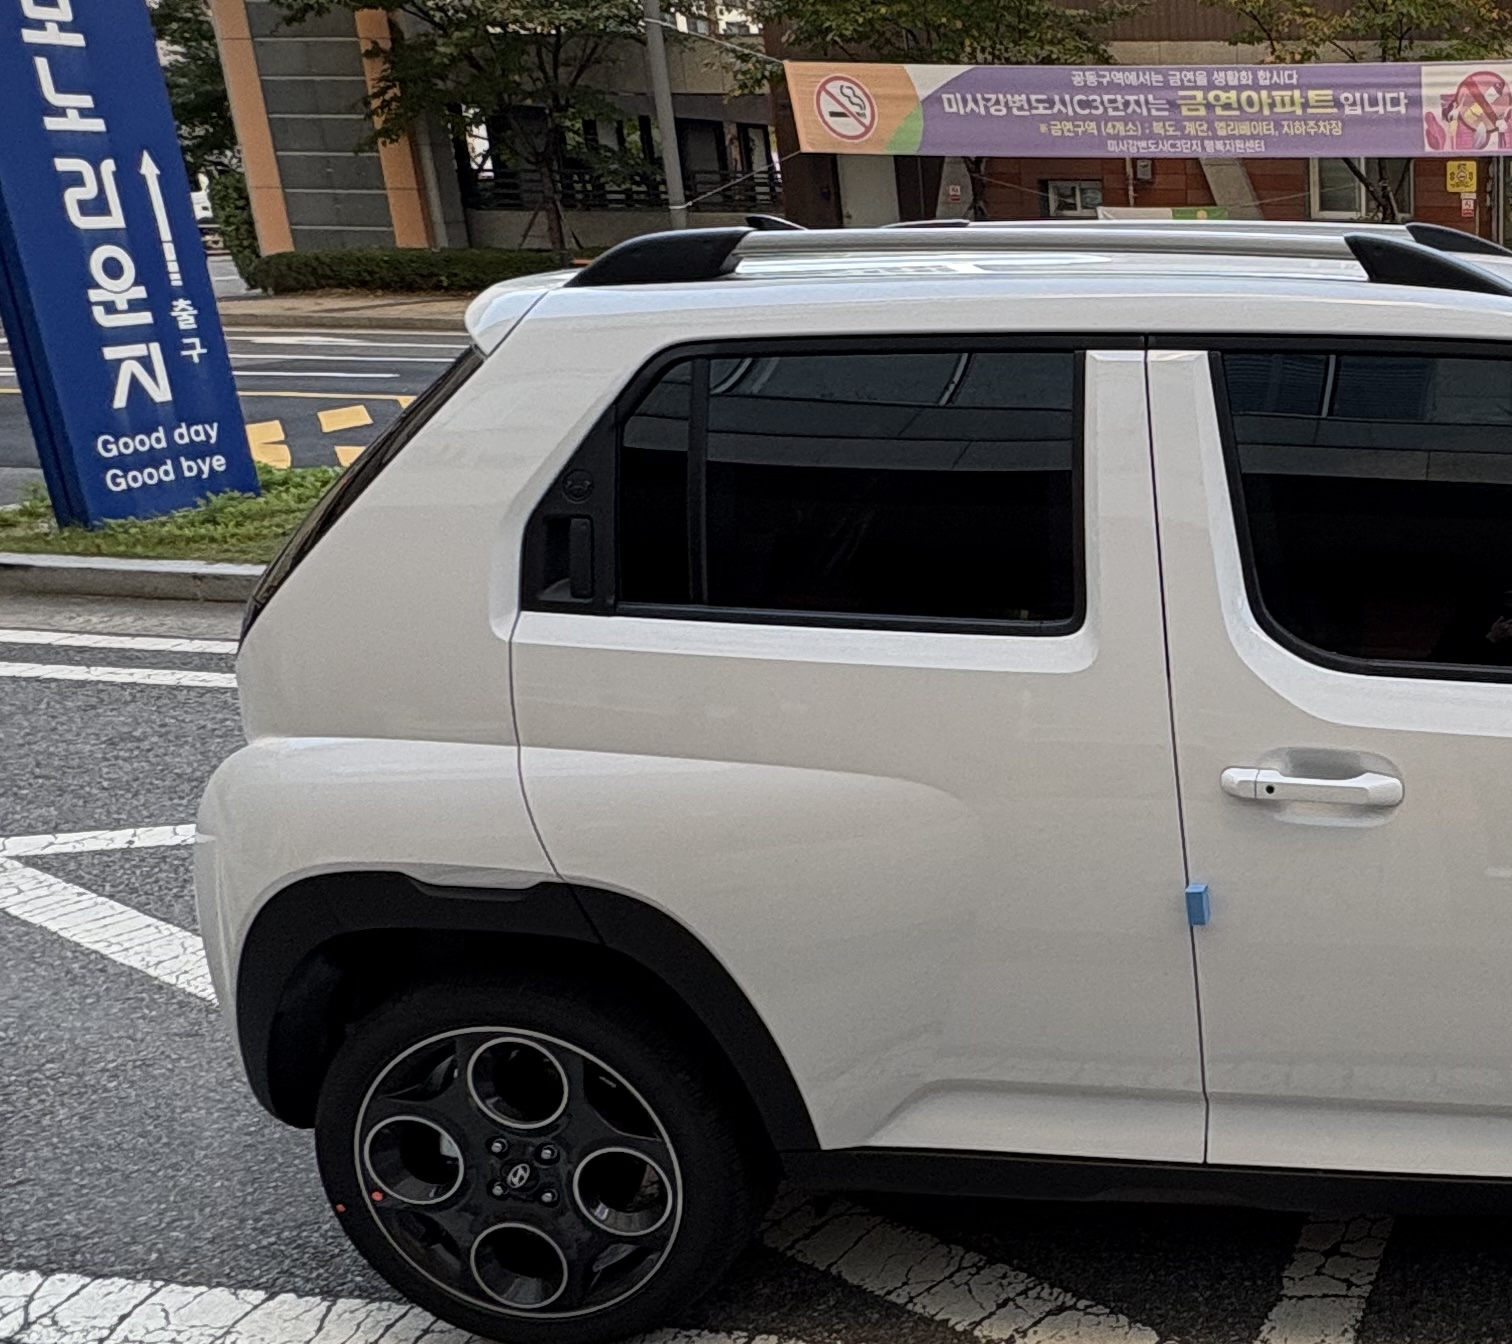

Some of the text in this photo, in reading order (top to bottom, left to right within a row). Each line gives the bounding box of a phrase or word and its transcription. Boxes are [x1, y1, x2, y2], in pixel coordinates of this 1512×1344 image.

[1071, 69, 1299, 87] 공동구역에서는 금연을 생활화 합시다
[941, 88, 1409, 117] 미사강변도시C3단지는 금연아파트 입니다
[170, 298, 208, 364] 출구
[97, 421, 219, 458] Good day
[105, 454, 227, 492] Good bye
